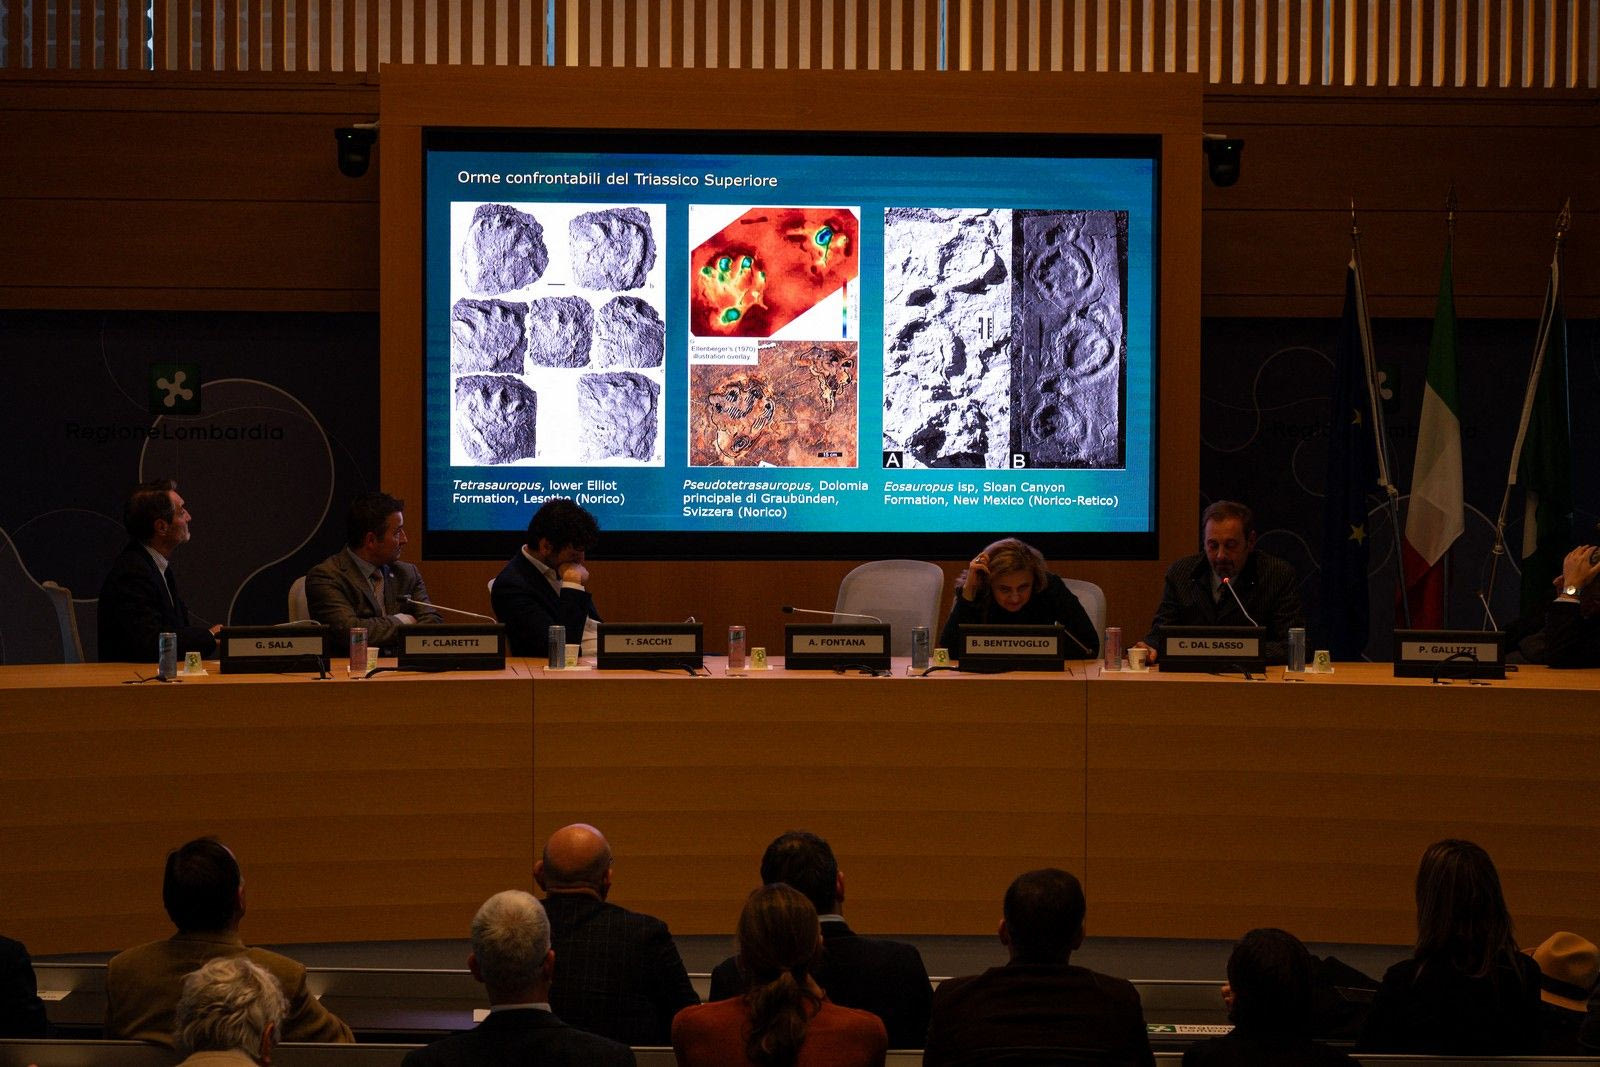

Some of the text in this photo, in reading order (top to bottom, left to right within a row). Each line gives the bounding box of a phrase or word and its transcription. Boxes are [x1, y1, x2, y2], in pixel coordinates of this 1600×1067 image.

[457, 170, 778, 189] Orme confrontabili del Triassico Superiore
[886, 454, 900, 468] A
[1013, 454, 1026, 468] B
[453, 480, 617, 492] Tetrasauropus, lower Elliot
[683, 480, 869, 492] Pseudotetrasauropus, Dolomia
[884, 482, 1065, 495] Eosauropus isp, Sloan Canyon
[453, 493, 519, 504] Formation,
[575, 493, 625, 506] (Norico)
[683, 493, 839, 506] principale di Graubünden,
[884, 495, 1119, 507] Formation, New Mexico (Norico-Retico)
[683, 507, 787, 519] Svizzera (Norico)
[255, 641, 294, 649] G. SALA
[983, 640, 1050, 648] BENTIVOGLIO
[1178, 641, 1244, 650] C. DAL SASSO
[1431, 646, 1477, 654] GALLIZZI
